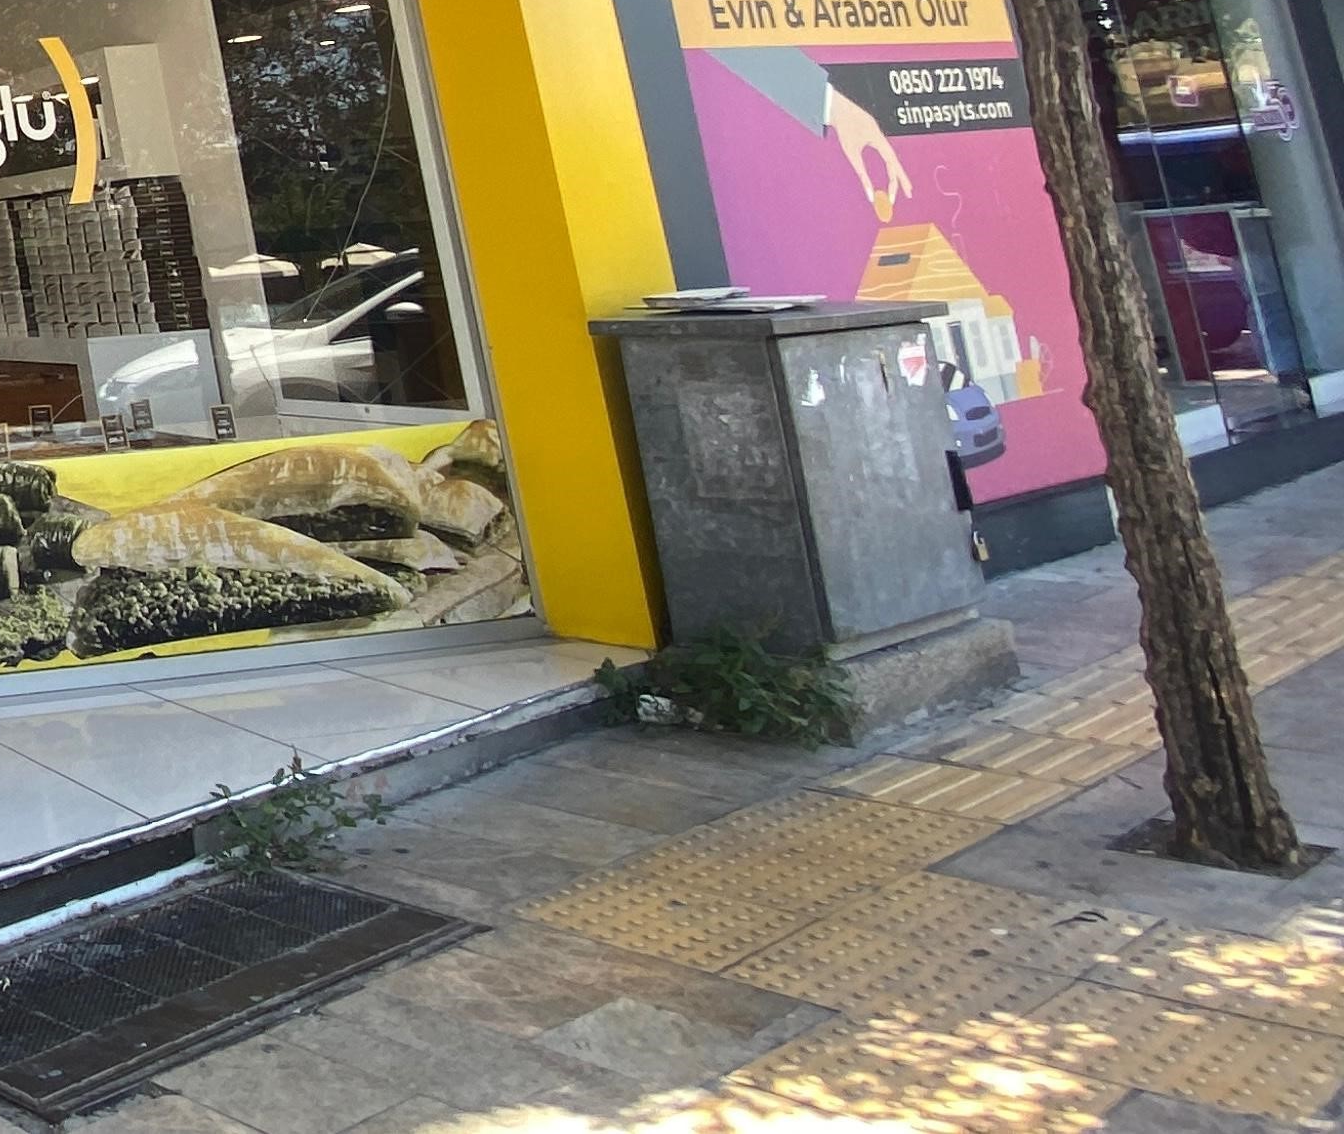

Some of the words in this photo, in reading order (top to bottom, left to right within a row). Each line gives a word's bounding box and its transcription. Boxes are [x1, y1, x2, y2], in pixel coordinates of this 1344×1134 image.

[889, 69, 934, 95] 0850
[934, 68, 967, 93] 222
[965, 66, 1004, 91] 1974
[897, 100, 1013, 129] sinpasyts.com
